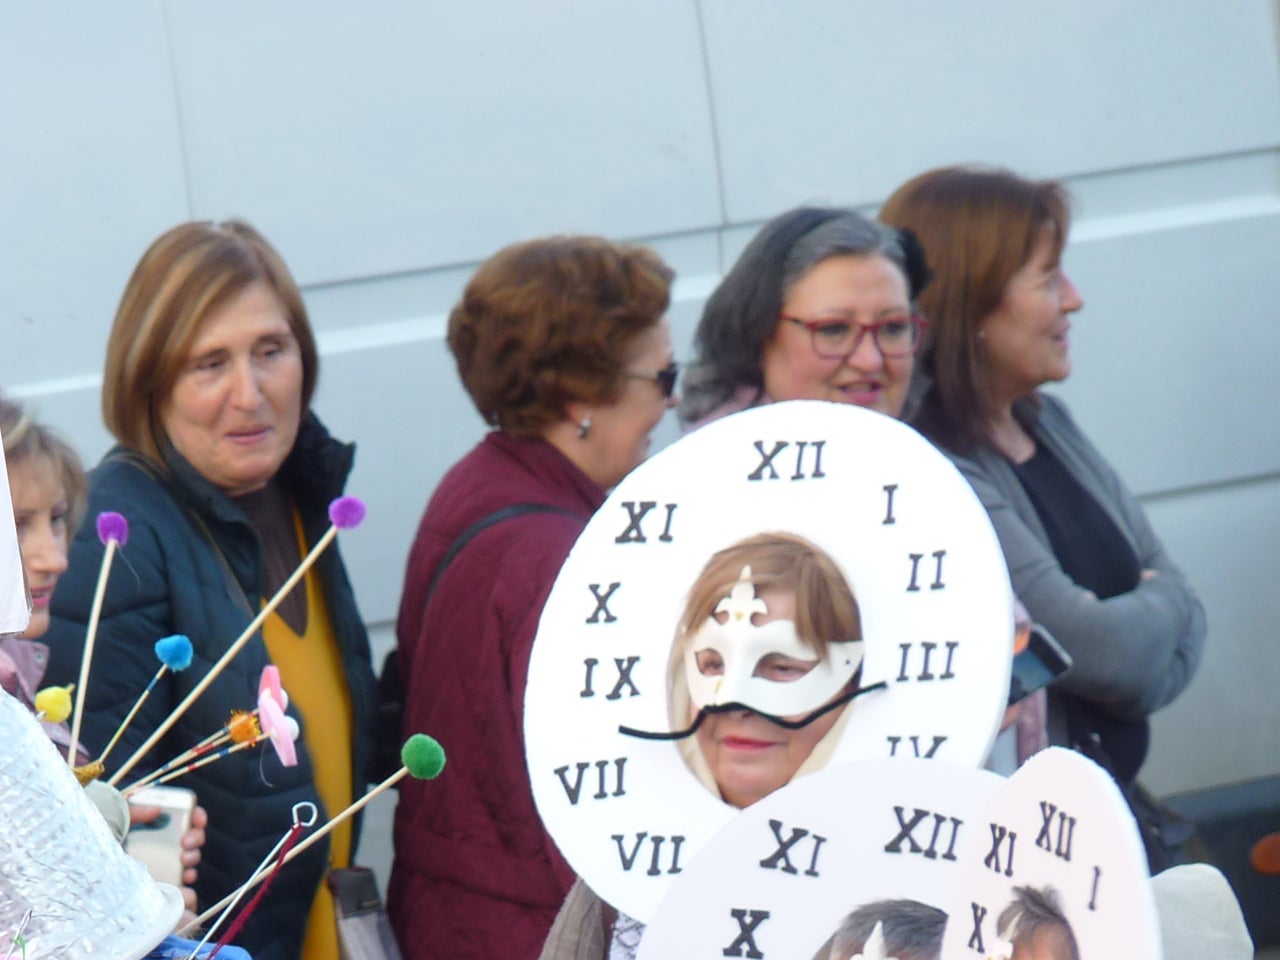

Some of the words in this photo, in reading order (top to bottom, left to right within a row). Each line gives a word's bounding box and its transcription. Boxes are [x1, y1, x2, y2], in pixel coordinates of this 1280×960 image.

[748, 441, 825, 480] XII
[615, 502, 676, 543] XI
[883, 485, 897, 524] I
[907, 551, 945, 591] II
[586, 583, 620, 623] X
[581, 657, 639, 700] IX
[897, 642, 957, 681] III
[554, 758, 627, 804] VII
[760, 820, 826, 876] XI
[885, 807, 962, 860] XII
[985, 824, 1016, 876] XI
[1036, 802, 1075, 861] XII
[612, 832, 685, 876] VII
[1090, 867, 1099, 910] I
[723, 909, 769, 960] X
[969, 903, 986, 953] X
